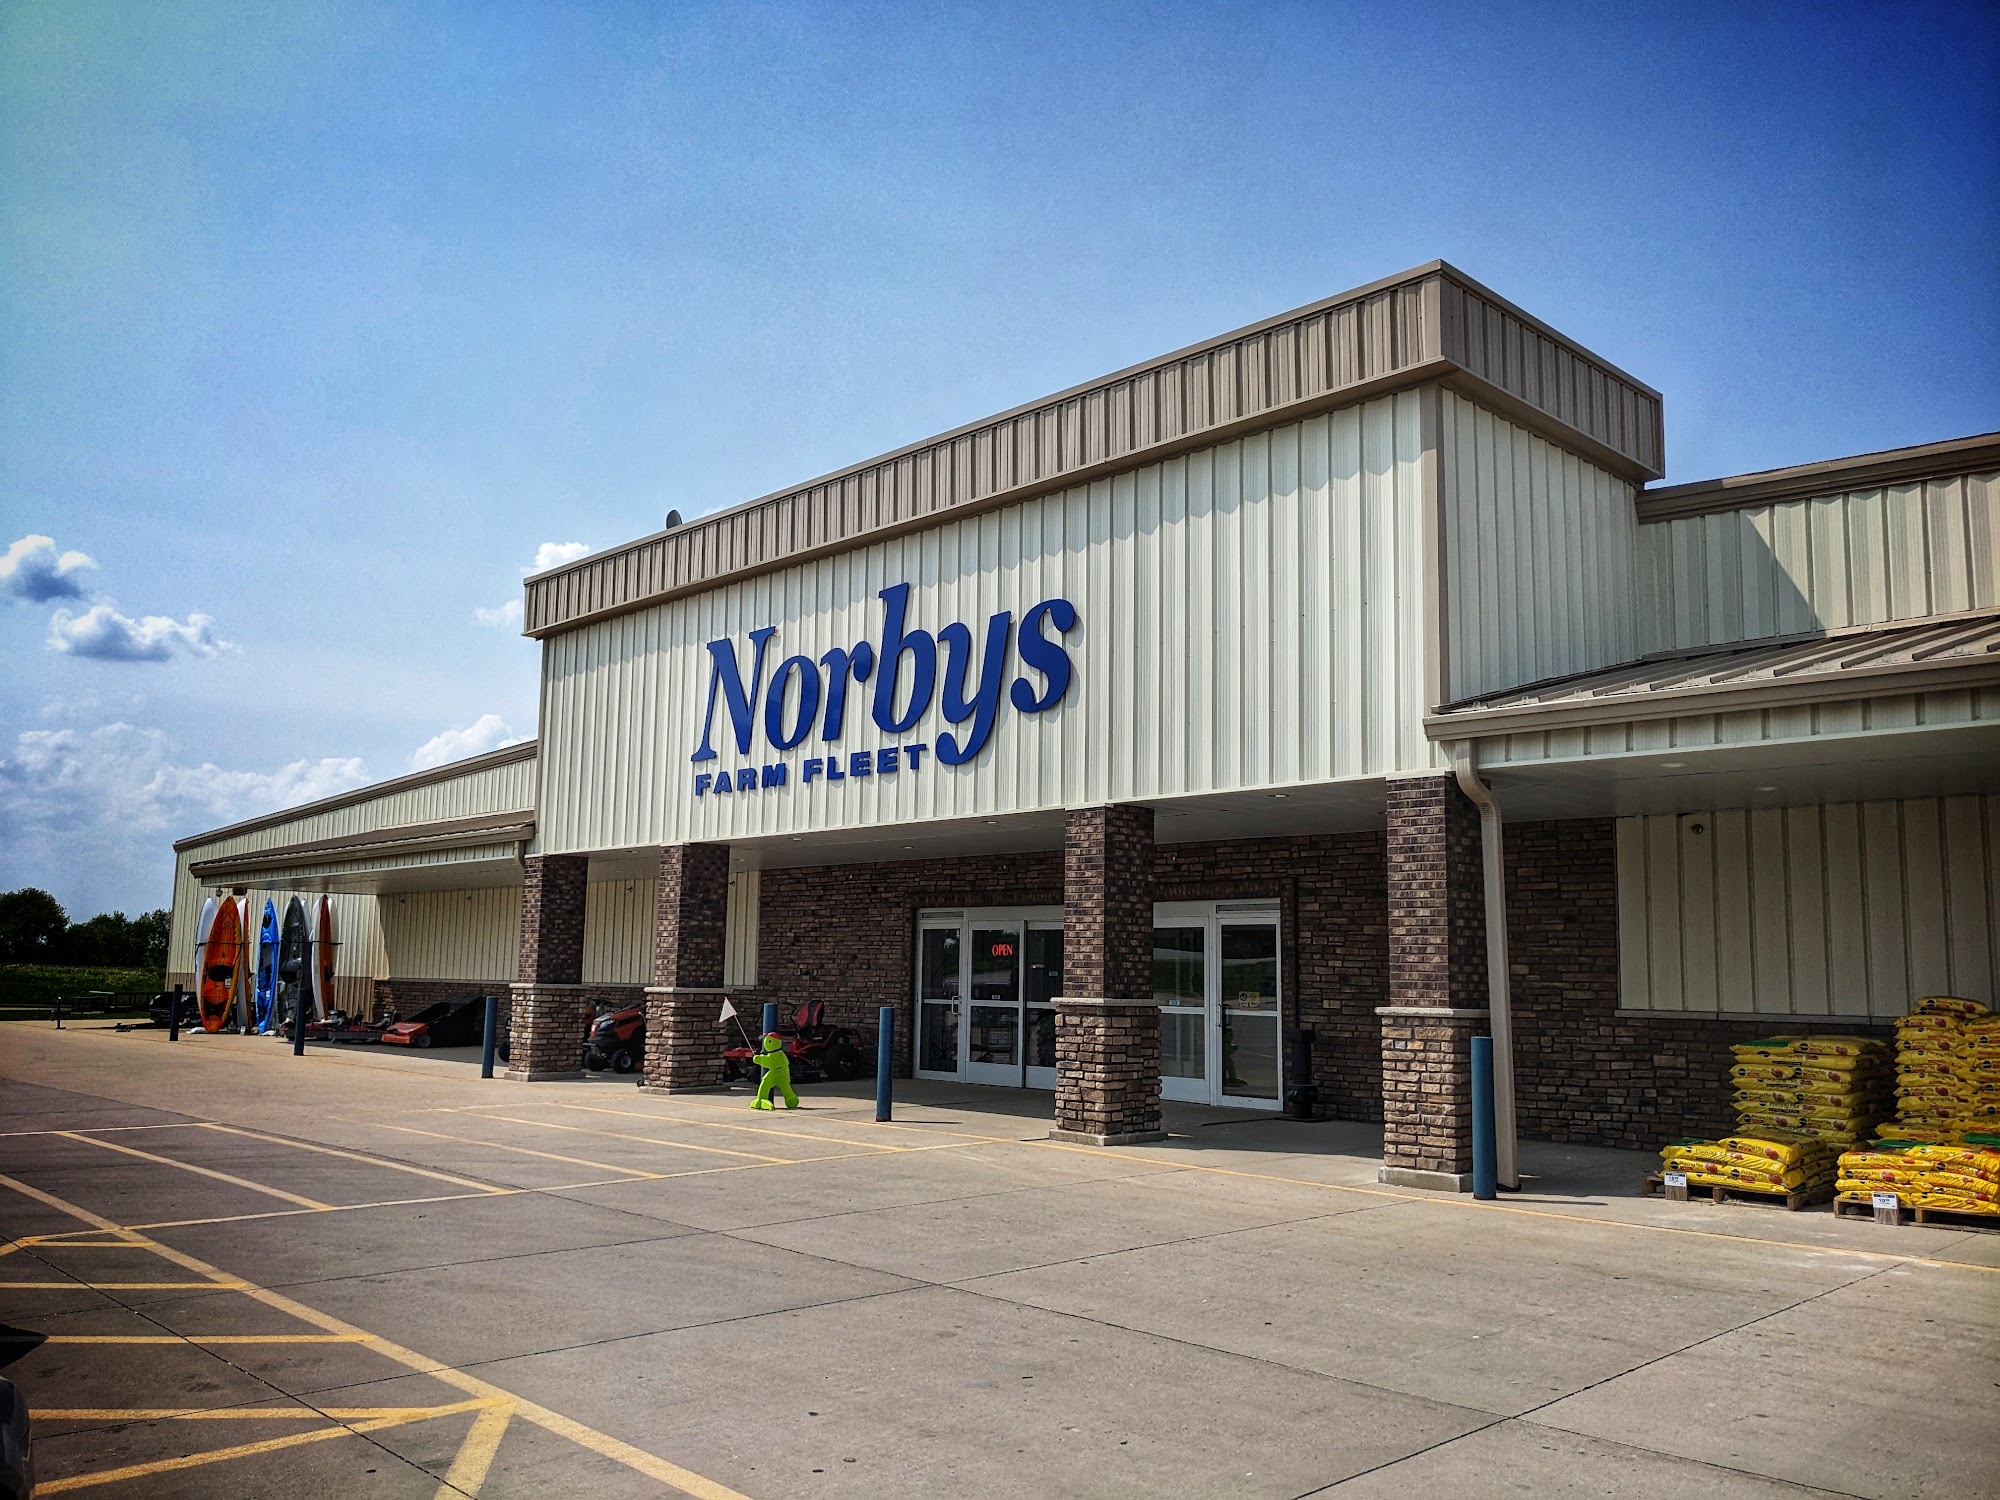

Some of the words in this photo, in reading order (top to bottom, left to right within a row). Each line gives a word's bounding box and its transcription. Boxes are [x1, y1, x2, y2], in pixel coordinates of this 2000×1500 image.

[691, 582, 1076, 765] Norbys
[695, 763, 786, 796] FARM
[802, 743, 927, 783] FLEET
[991, 944, 1013, 956] OPEN
